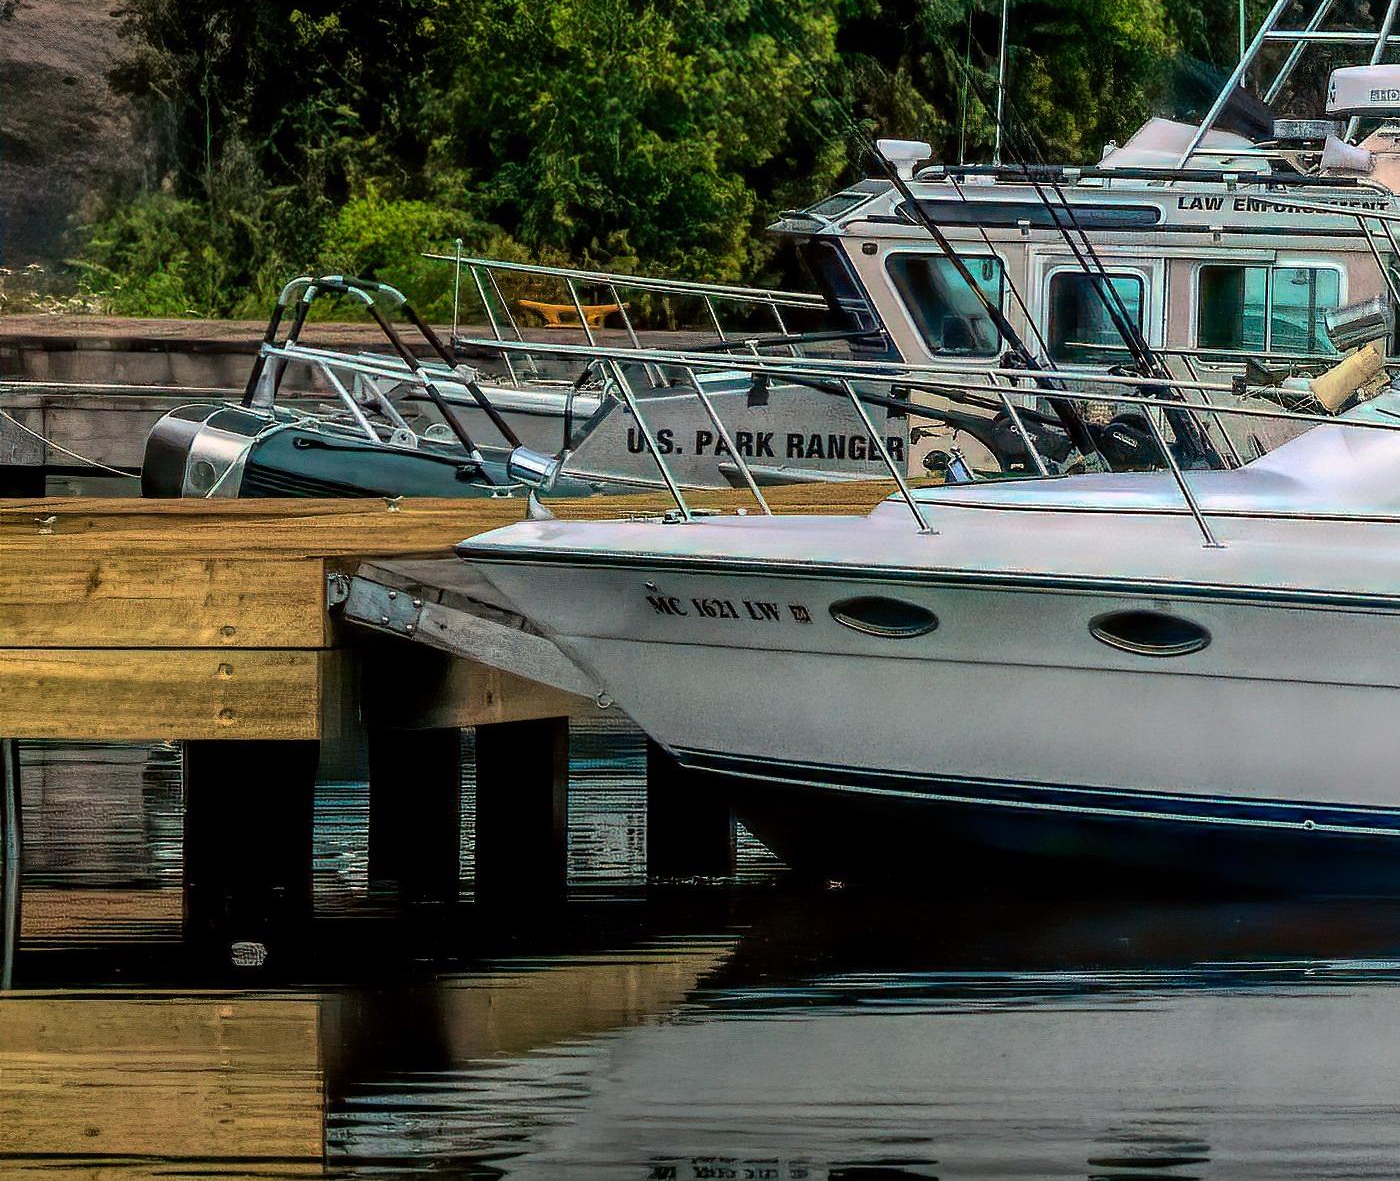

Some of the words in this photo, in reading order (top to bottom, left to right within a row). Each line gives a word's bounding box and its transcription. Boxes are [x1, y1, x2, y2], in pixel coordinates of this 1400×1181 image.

[1177, 196, 1222, 210] LAW
[627, 428, 682, 454] U.S.
[696, 431, 774, 457] PARK
[786, 433, 904, 462] RANGER
[646, 596, 688, 616] MC
[692, 598, 740, 619] 1621
[743, 600, 780, 621] LW
